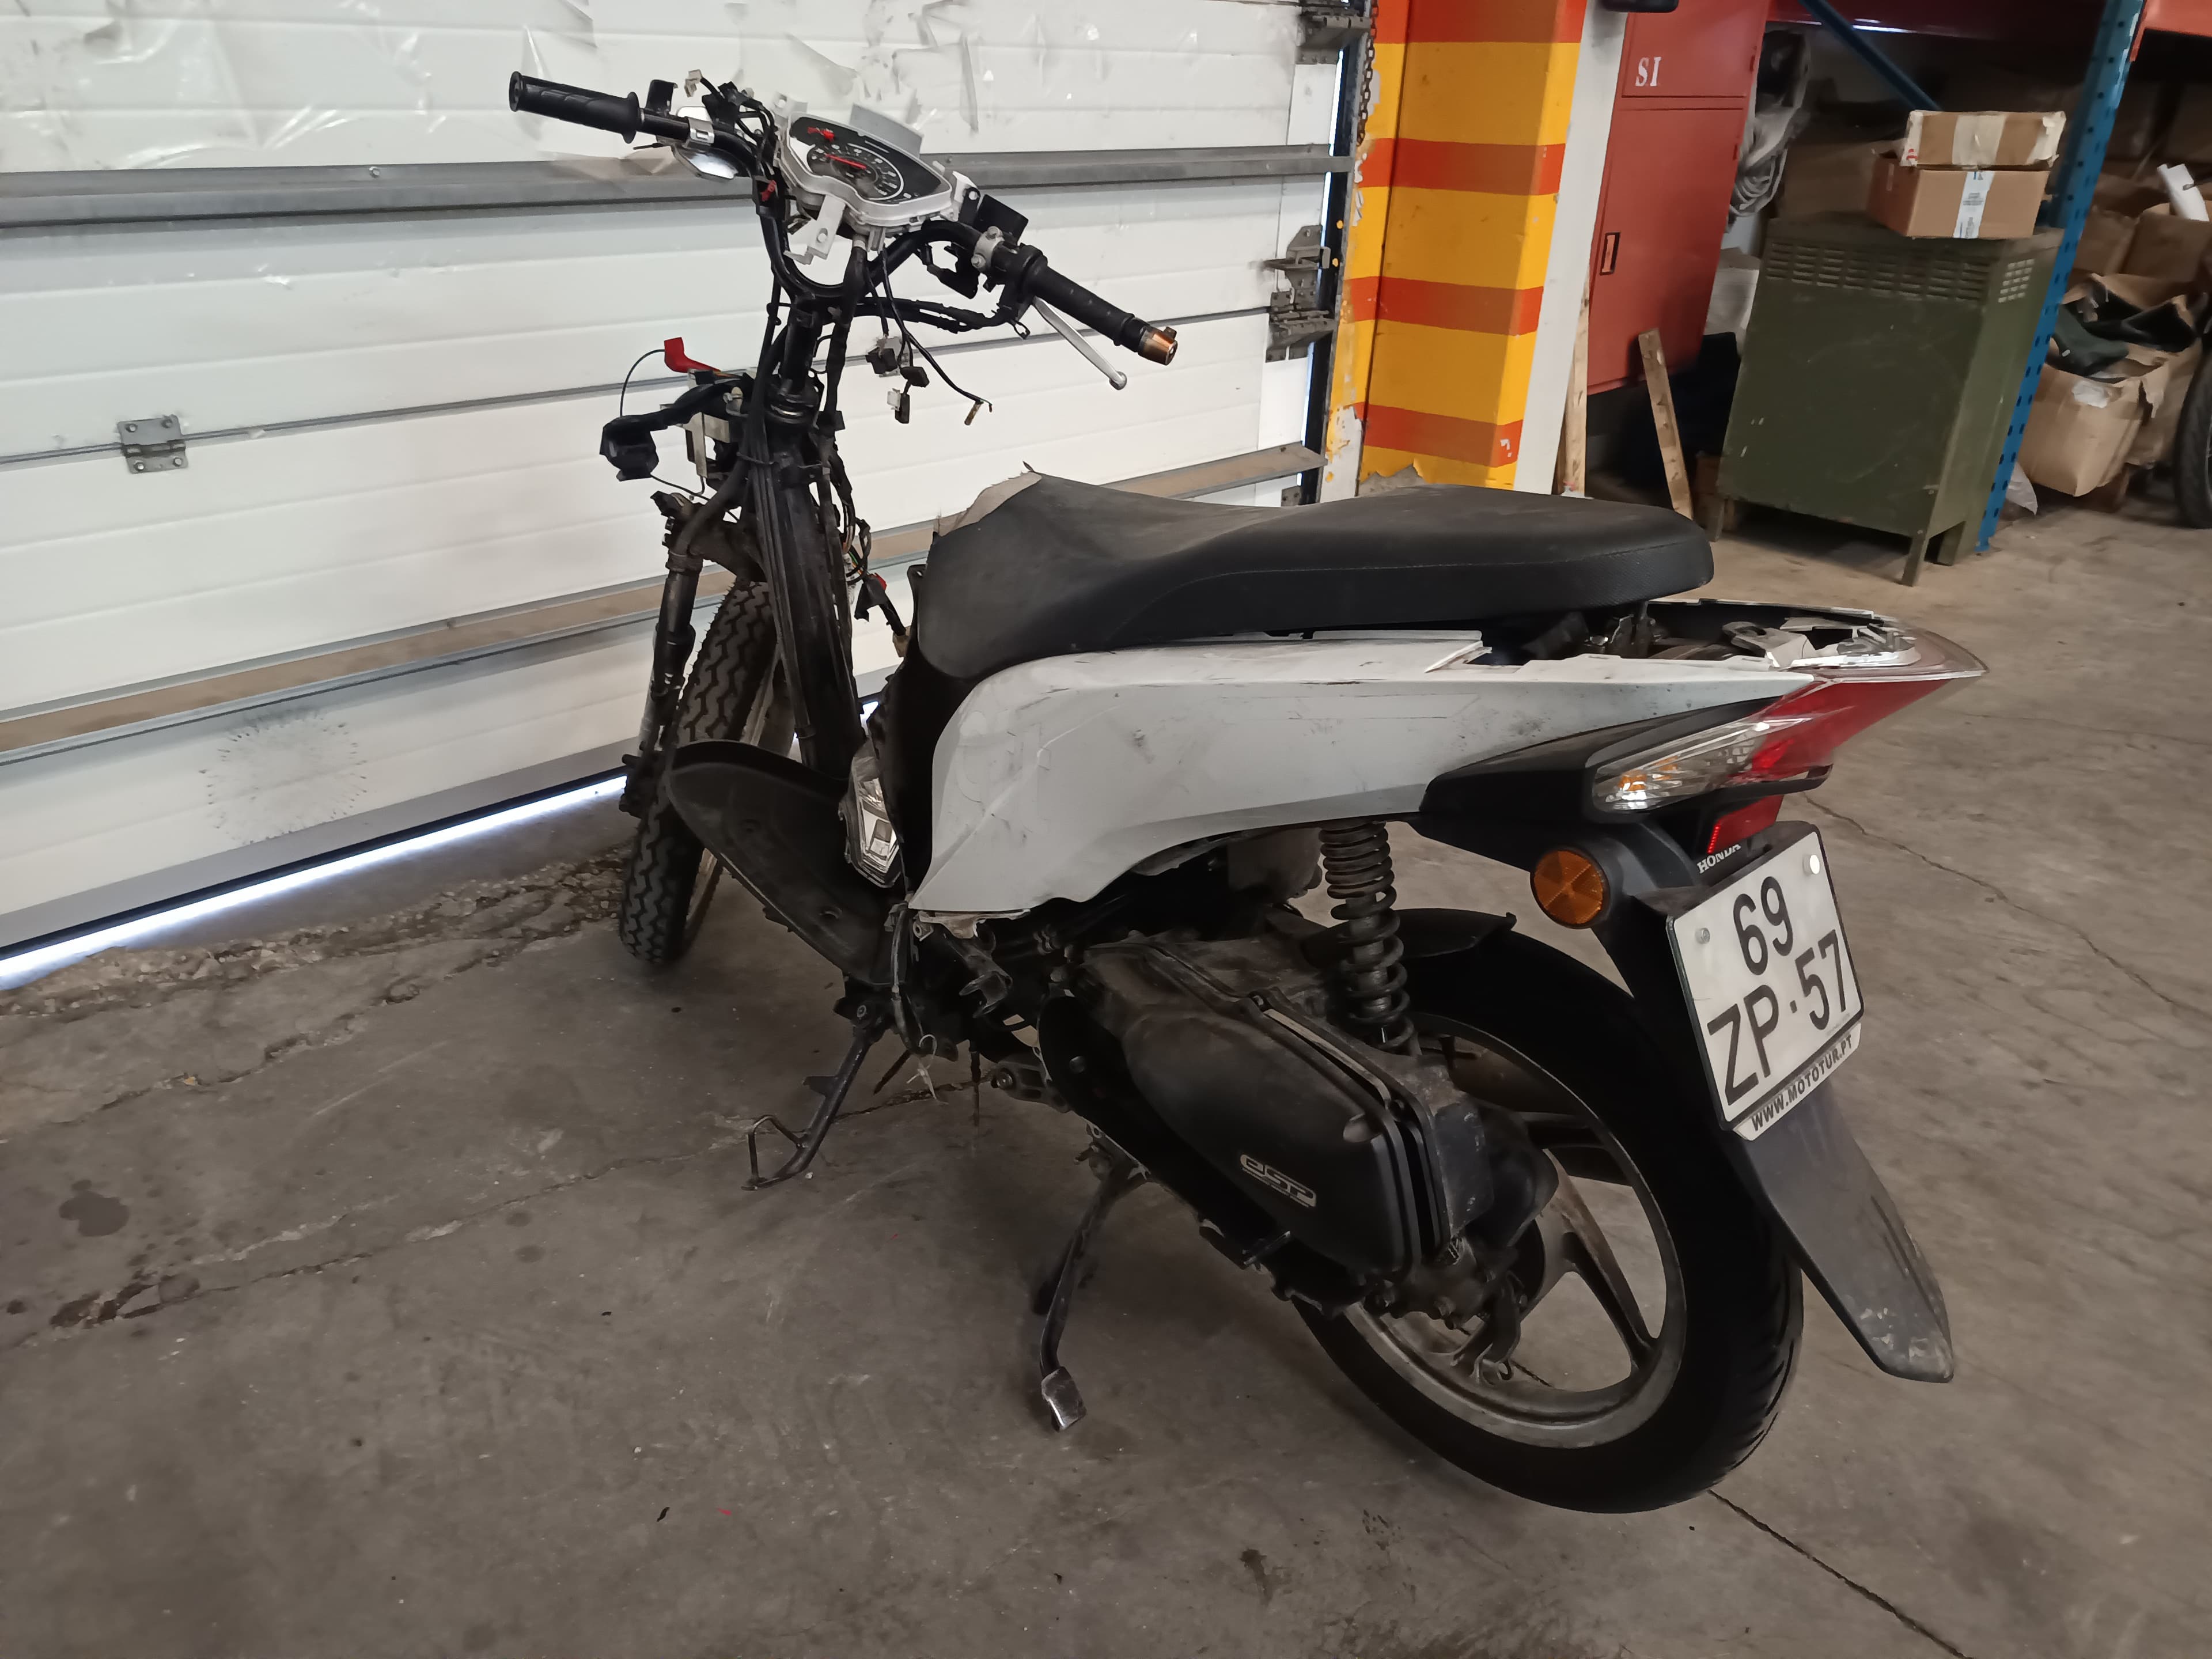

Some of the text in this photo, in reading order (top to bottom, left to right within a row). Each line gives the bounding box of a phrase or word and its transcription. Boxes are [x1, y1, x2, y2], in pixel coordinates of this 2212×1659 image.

[1635, 56, 1662, 87] SI
[1733, 876, 1794, 975] 69
[1751, 1034, 1852, 1132] WWW.MOTOTUR.PT
